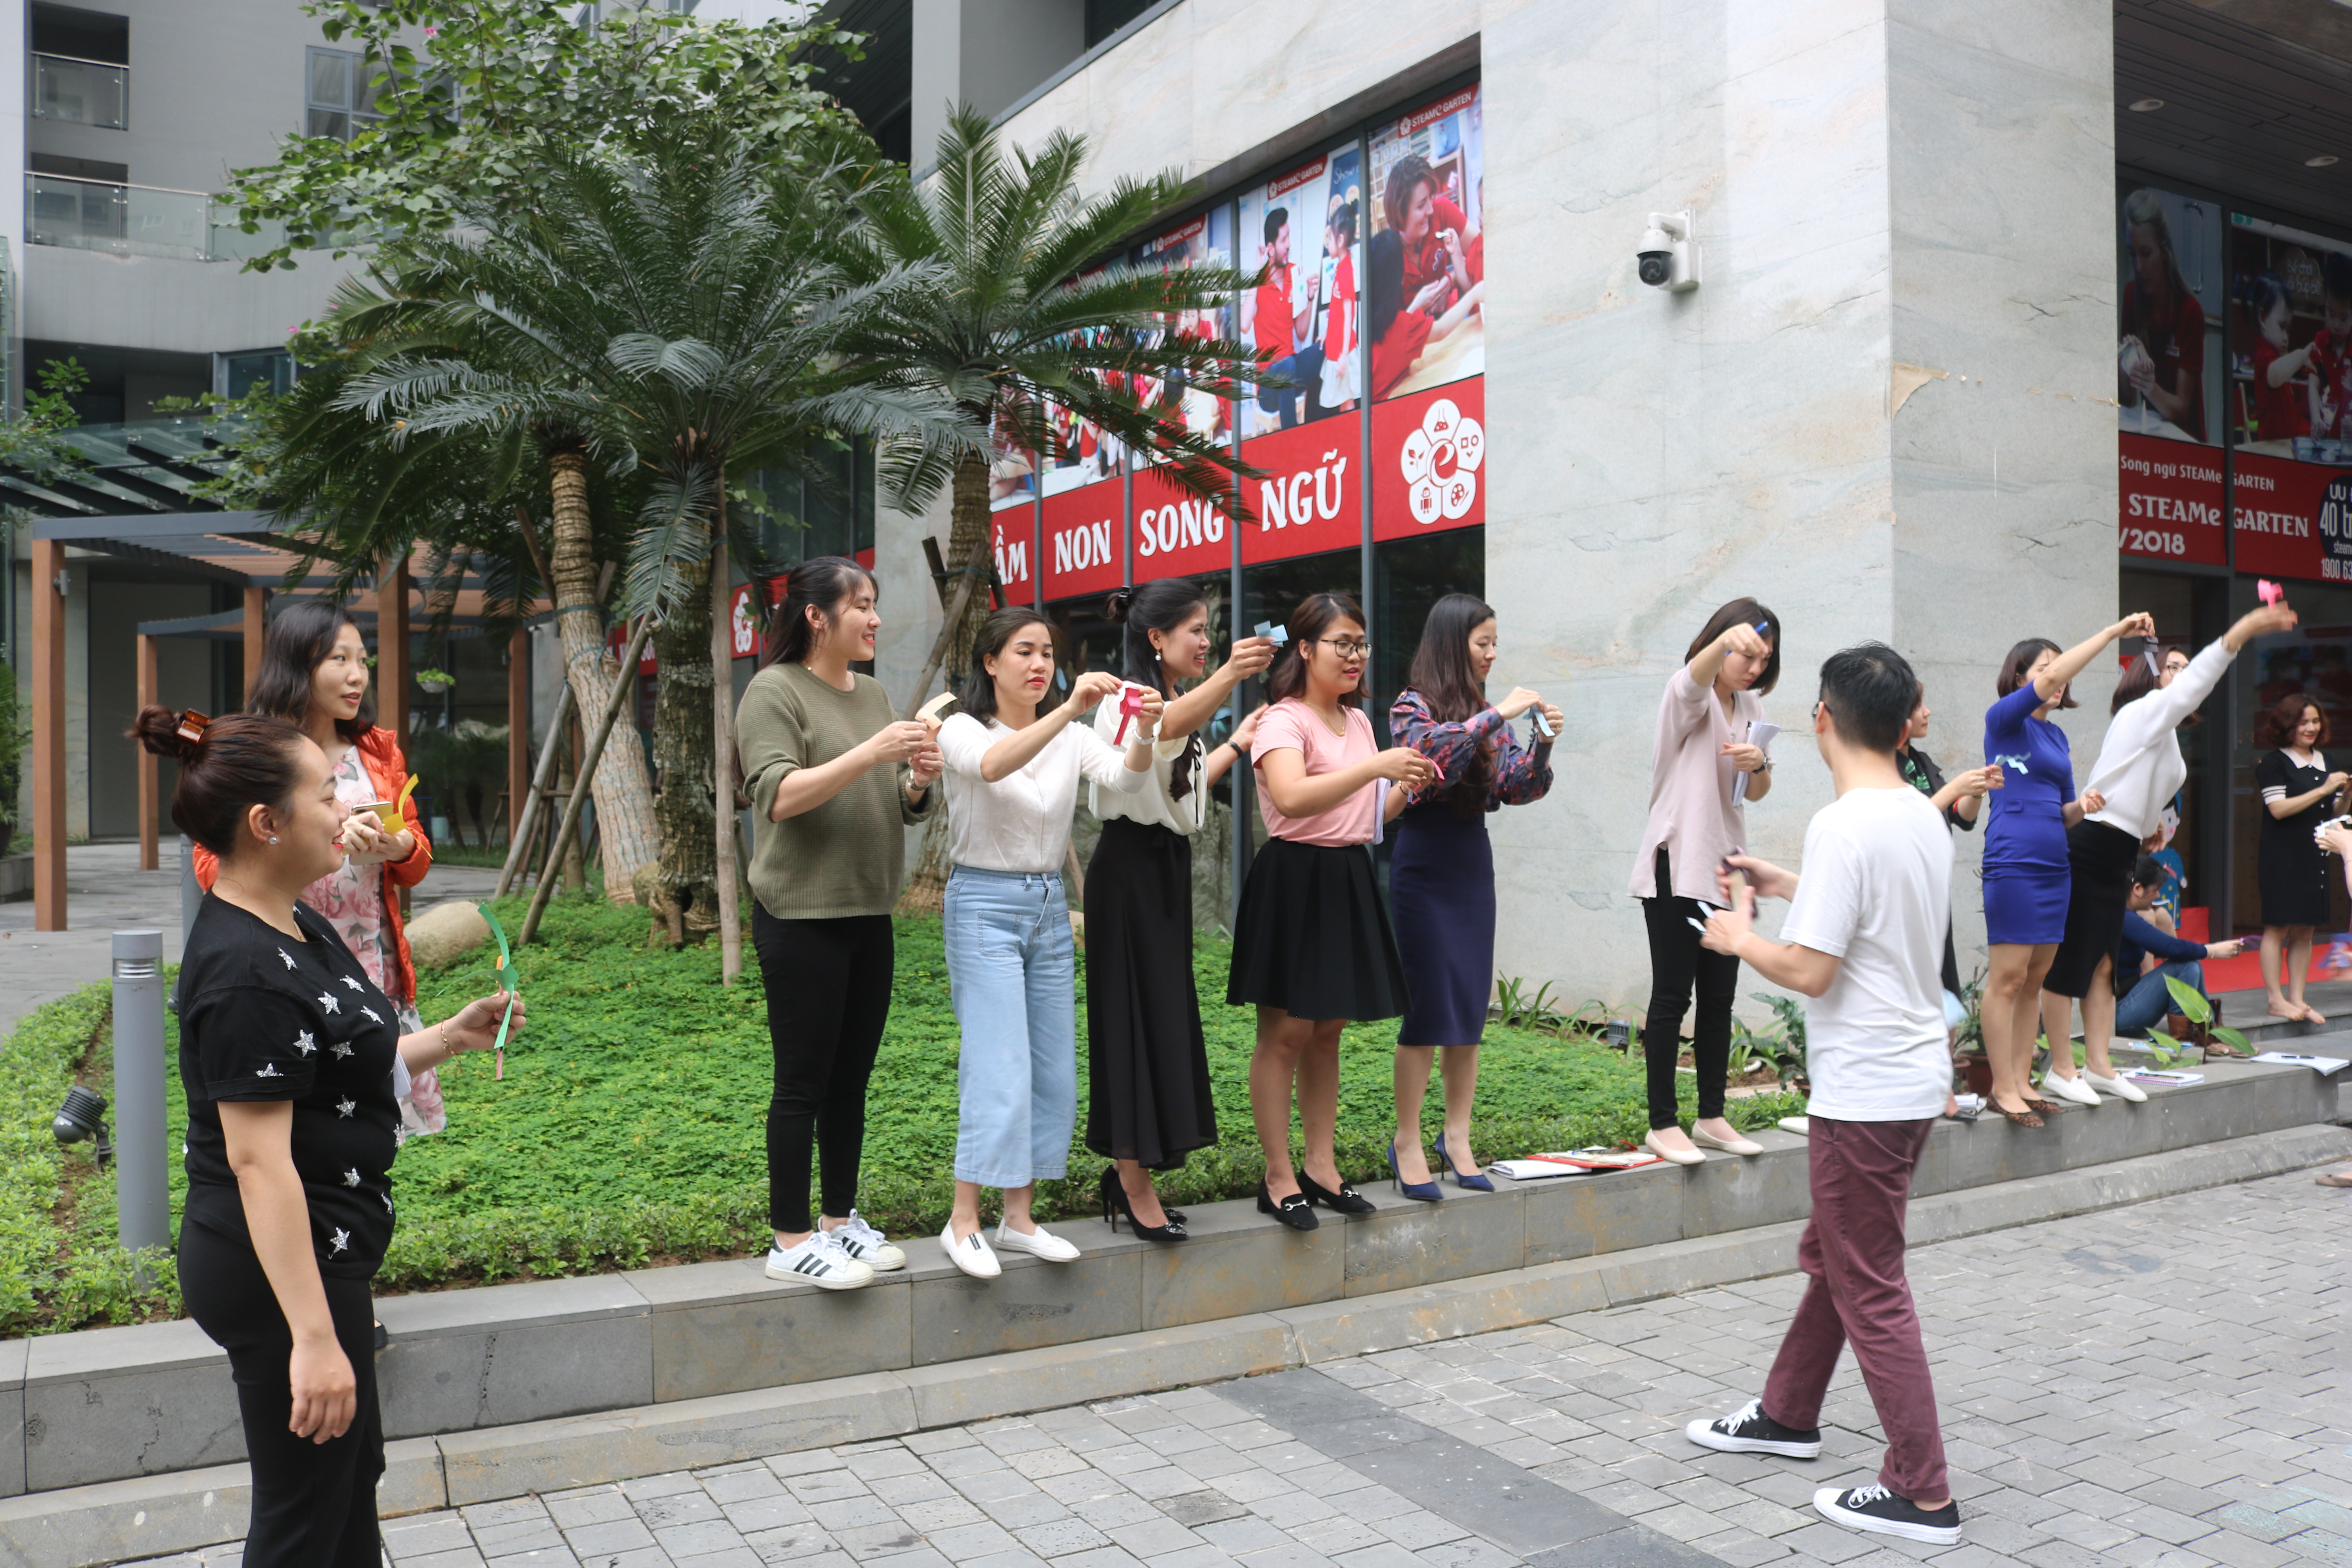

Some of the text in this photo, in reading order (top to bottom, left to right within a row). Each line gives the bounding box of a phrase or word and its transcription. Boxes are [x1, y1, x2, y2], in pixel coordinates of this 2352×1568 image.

[1443, 92, 1471, 112] GARTEN
[1301, 163, 1323, 180] GARTEN
[2120, 455, 2150, 476] Song
[2180, 464, 2222, 483] STEAMe
[995, 448, 1347, 585] ẦM NON SONG NGỮ
[2128, 493, 2221, 526] STEAMe
[2319, 501, 2338, 537] 40
[2119, 527, 2185, 555] /2018
[2334, 540, 2352, 555] steam
[2321, 557, 2352, 581] 1900 63
